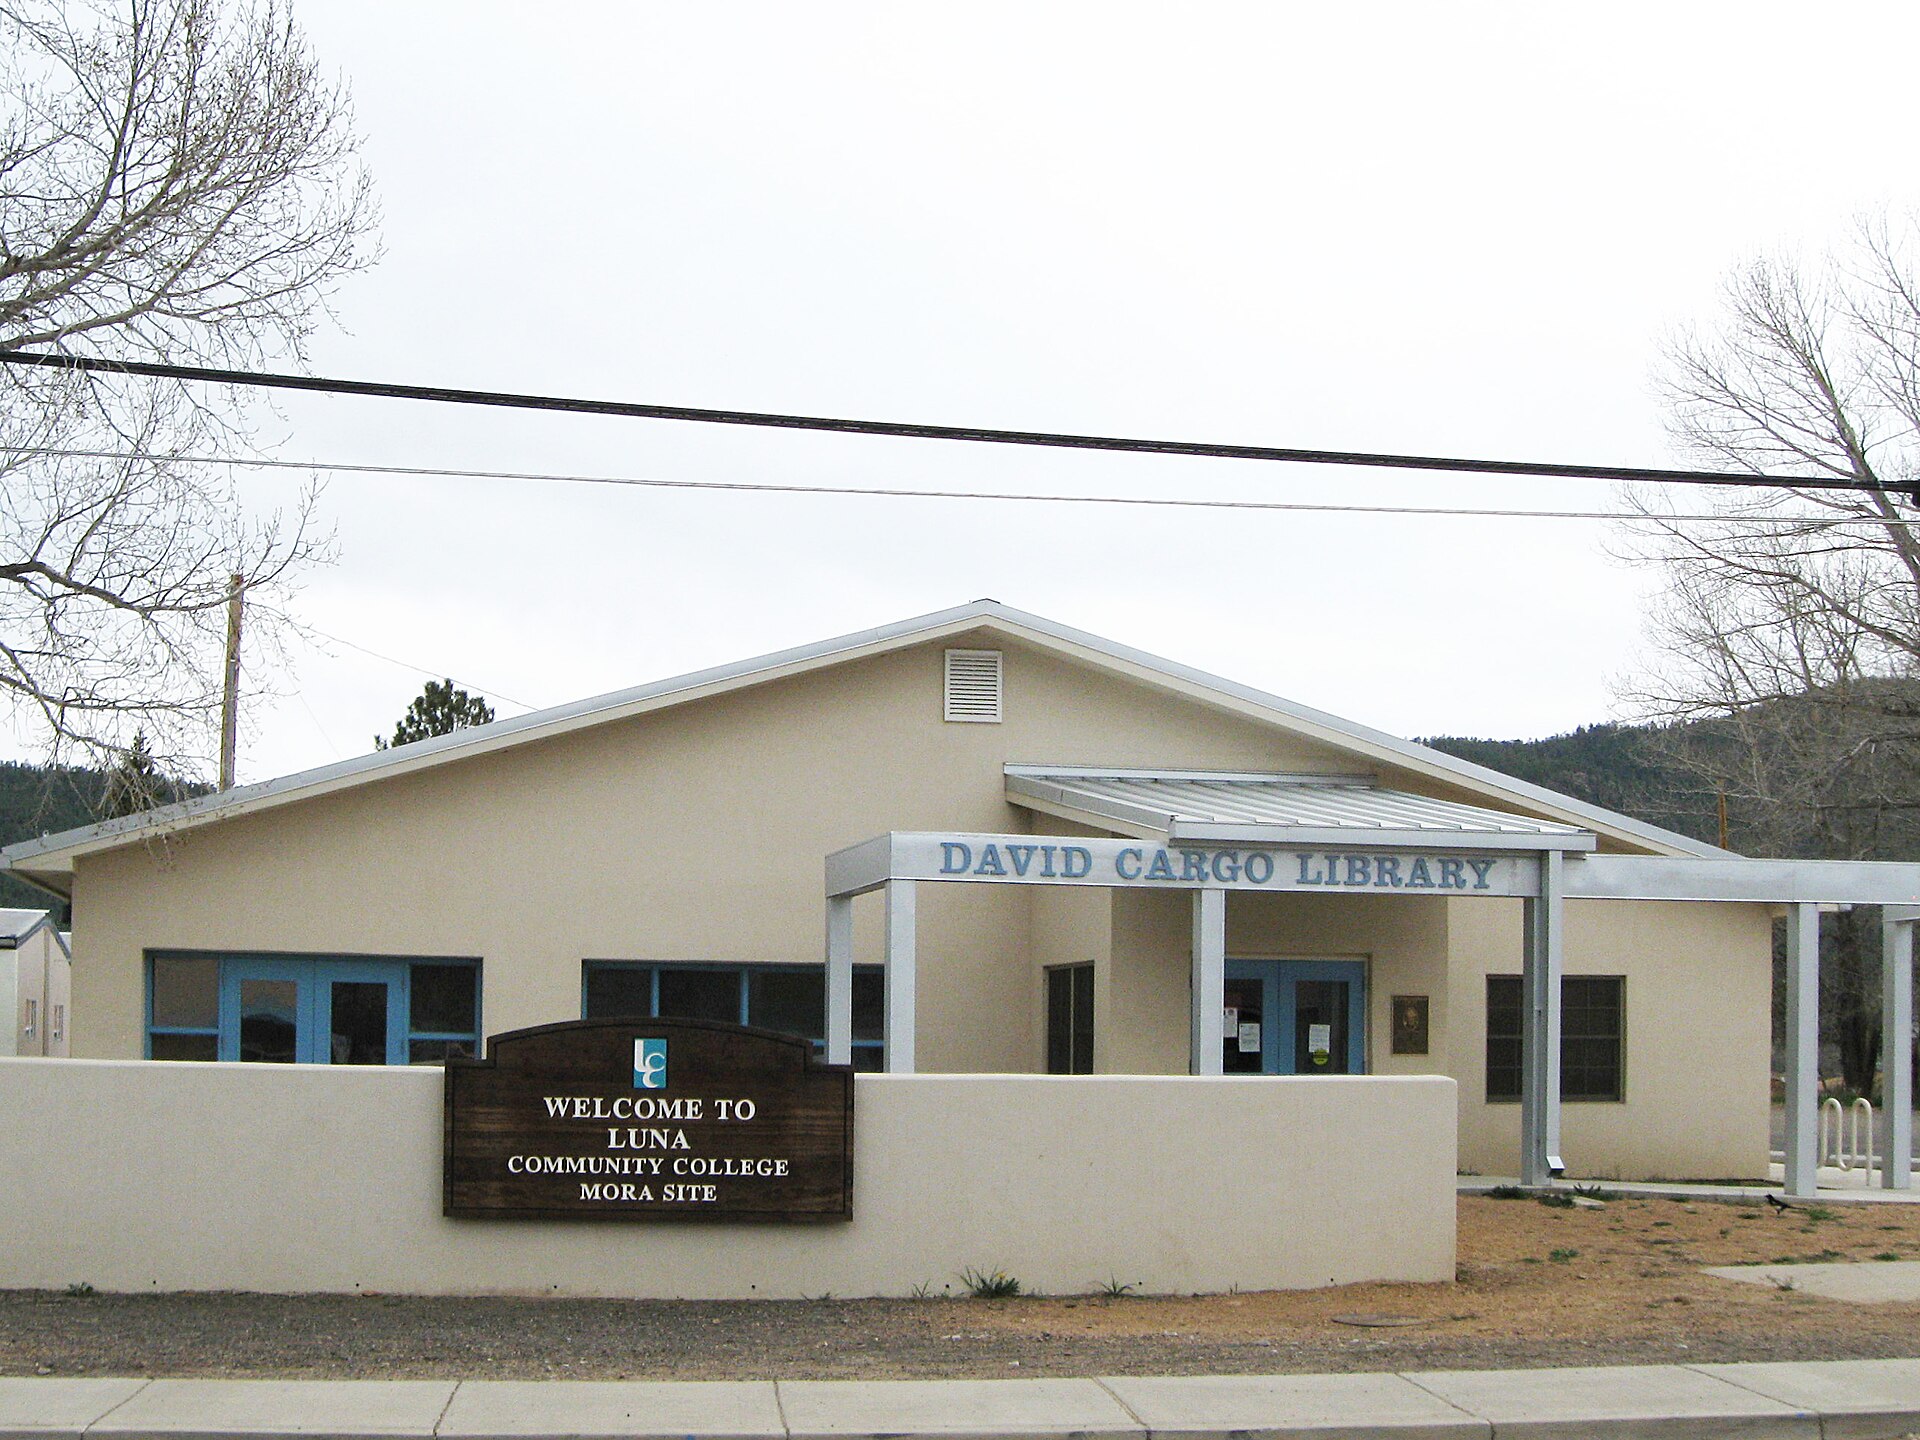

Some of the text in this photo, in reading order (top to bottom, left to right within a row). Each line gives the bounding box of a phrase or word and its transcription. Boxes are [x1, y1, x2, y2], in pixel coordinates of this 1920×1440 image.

[940, 842, 1497, 889] DAVID CARGO LIBRARY
[543, 1097, 756, 1121] WELCOME TO
[608, 1128, 691, 1150] LUNA
[507, 1156, 789, 1177] COMMUNITY COLLEGE
[579, 1183, 717, 1202] MORA SITE
